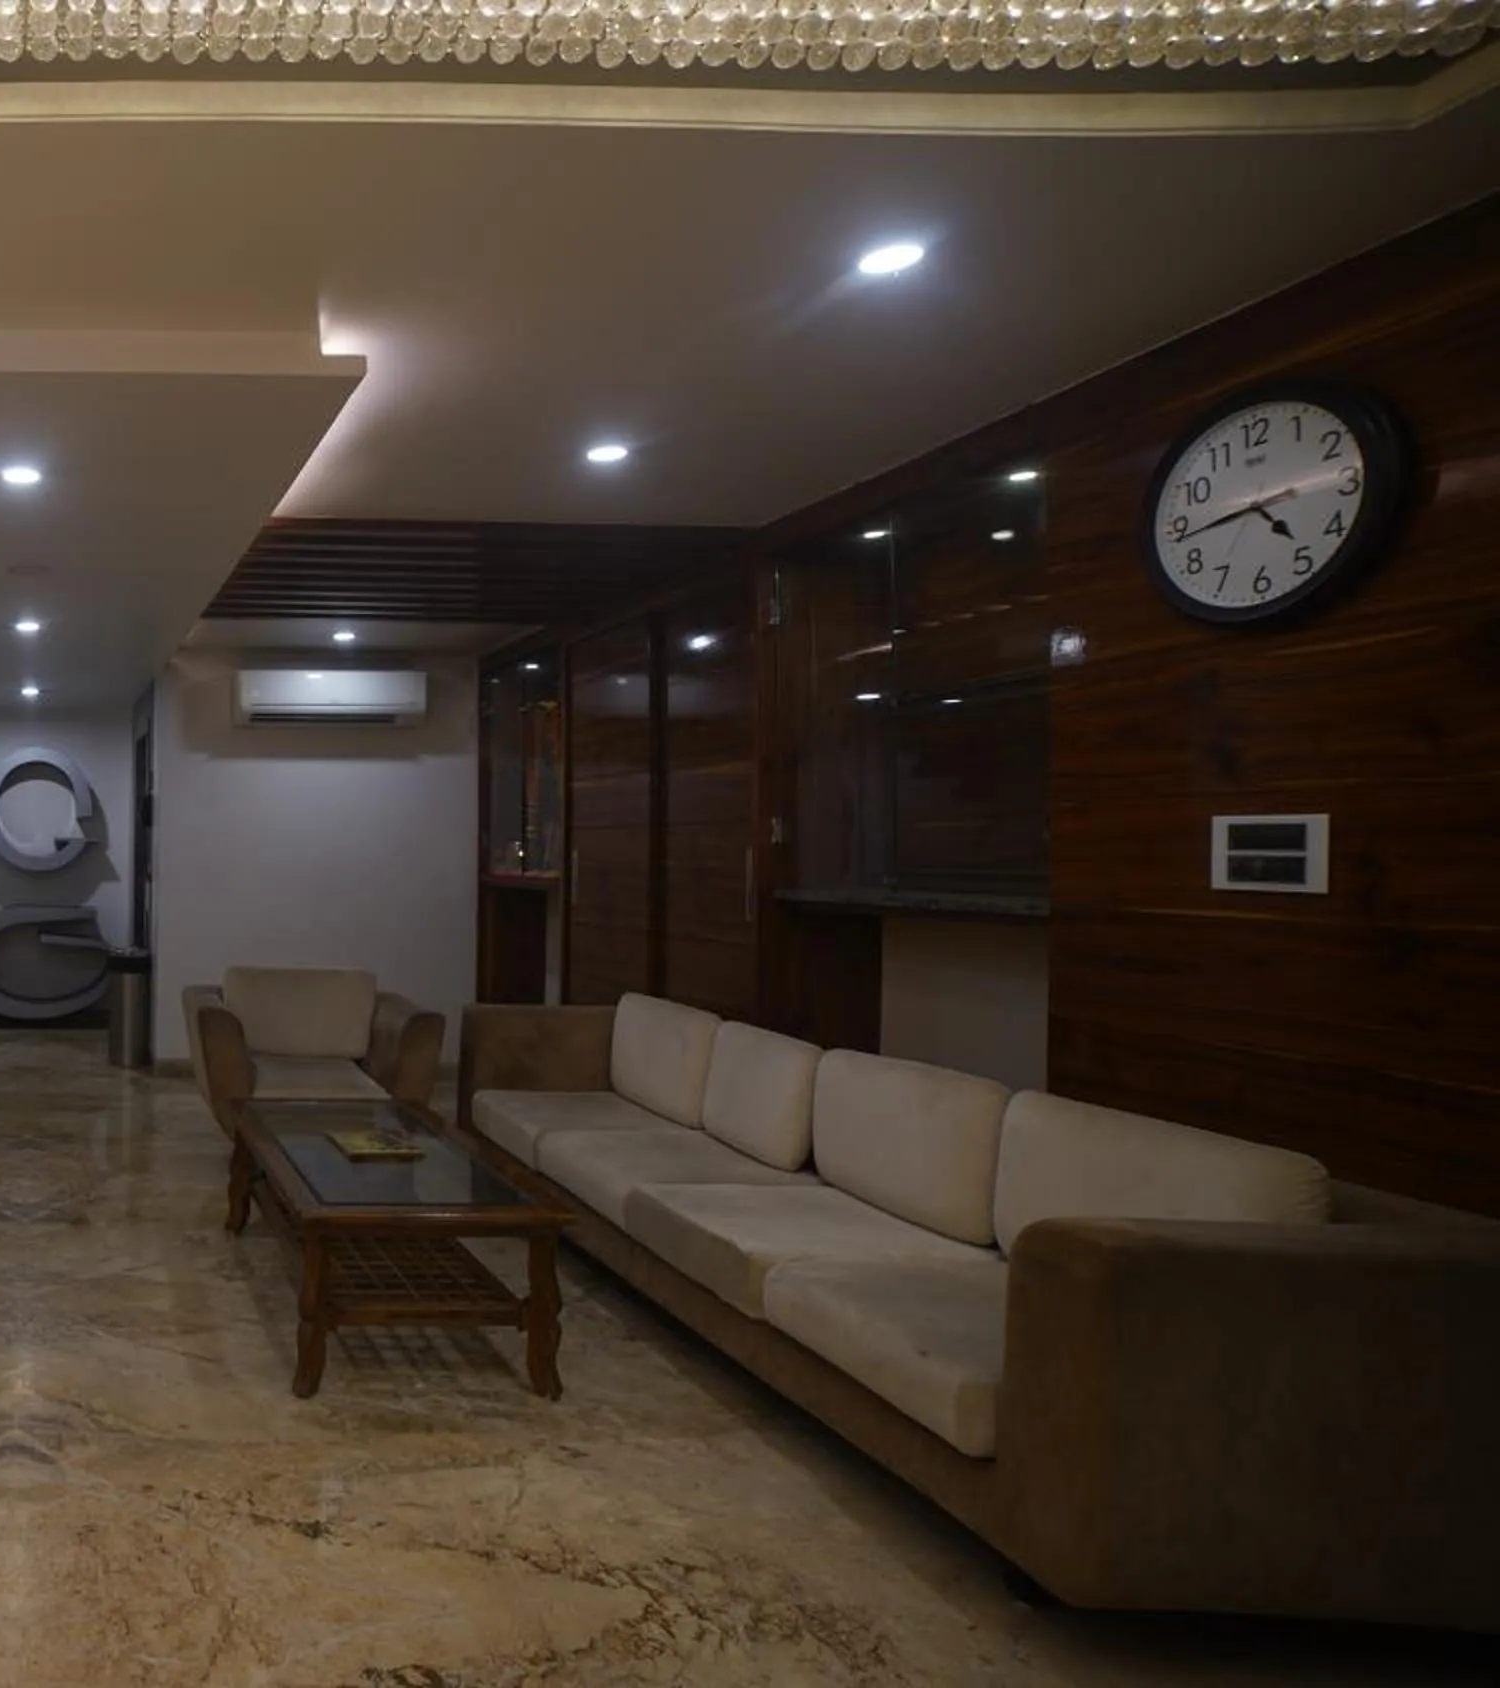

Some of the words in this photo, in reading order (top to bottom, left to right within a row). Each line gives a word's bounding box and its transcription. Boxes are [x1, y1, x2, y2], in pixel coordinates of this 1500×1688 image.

[1239, 417, 1270, 449] 12
[1291, 415, 1303, 442] 1
[1208, 443, 1231, 472] 11
[1321, 430, 1342, 461] 2
[1184, 477, 1211, 506] 10
[1337, 467, 1361, 496] 3
[1173, 516, 1189, 541] 9
[1323, 510, 1346, 538] 4
[1186, 548, 1203, 575] 8
[1293, 546, 1314, 575] 5
[1213, 565, 1230, 593] 7
[1252, 566, 1272, 594] 6
